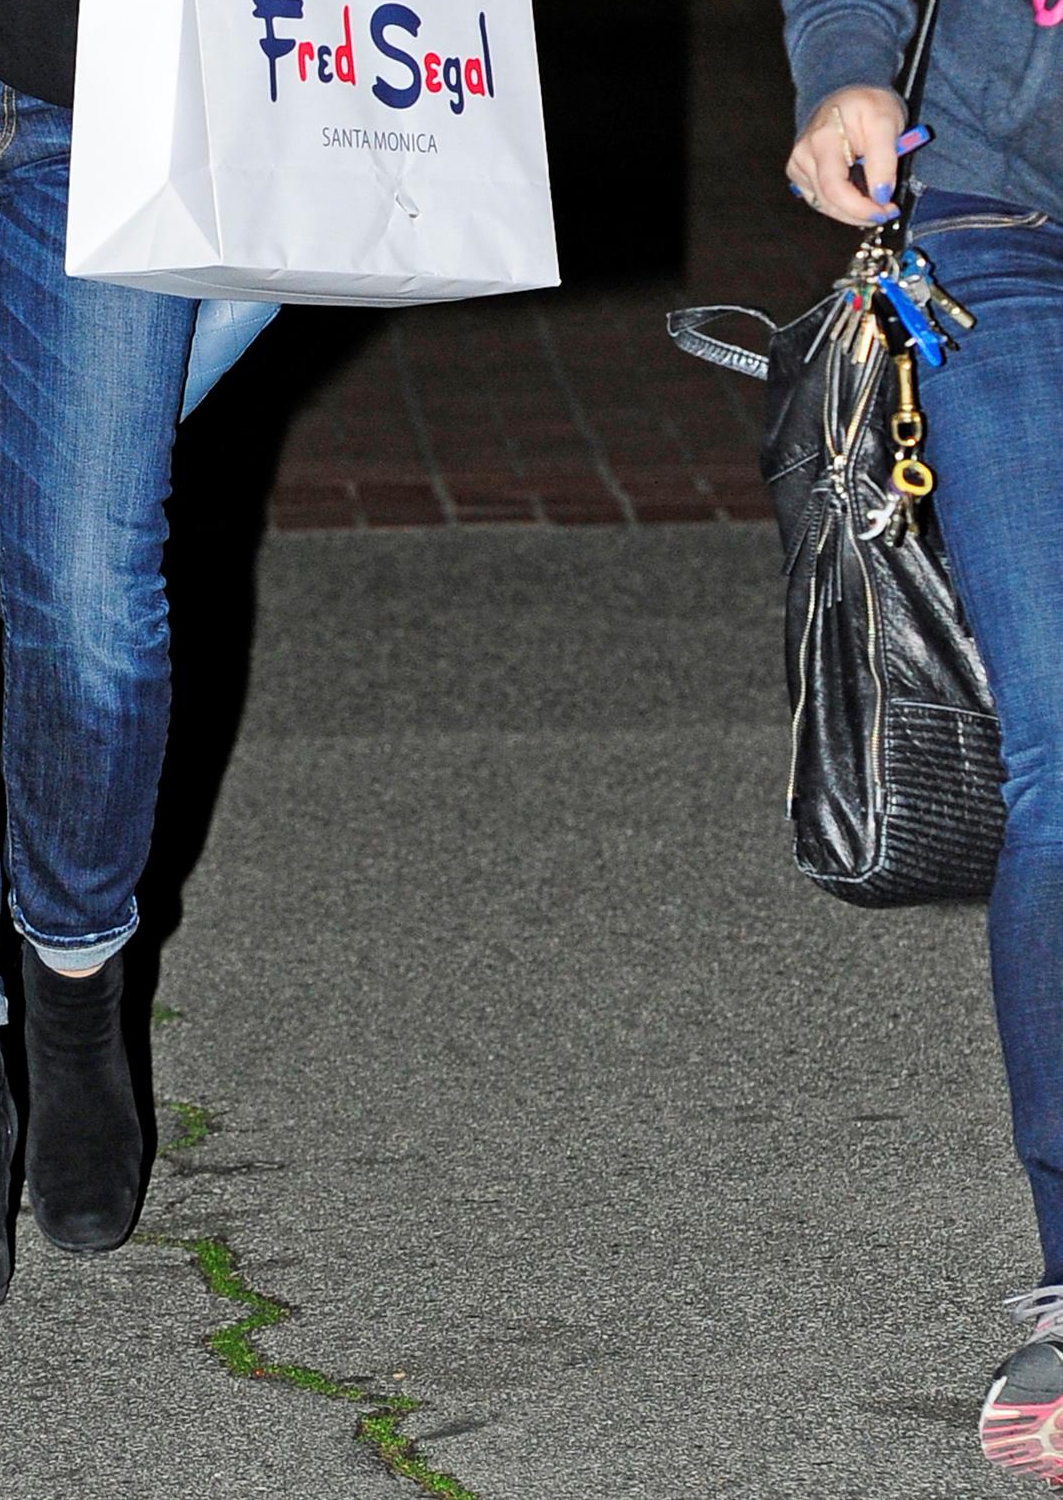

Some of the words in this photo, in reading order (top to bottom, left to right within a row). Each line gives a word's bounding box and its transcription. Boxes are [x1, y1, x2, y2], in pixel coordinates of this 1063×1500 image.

[370, 3, 494, 115] Segal
[322, 126, 372, 149] SANTA
[374, 130, 438, 154] MONICA
